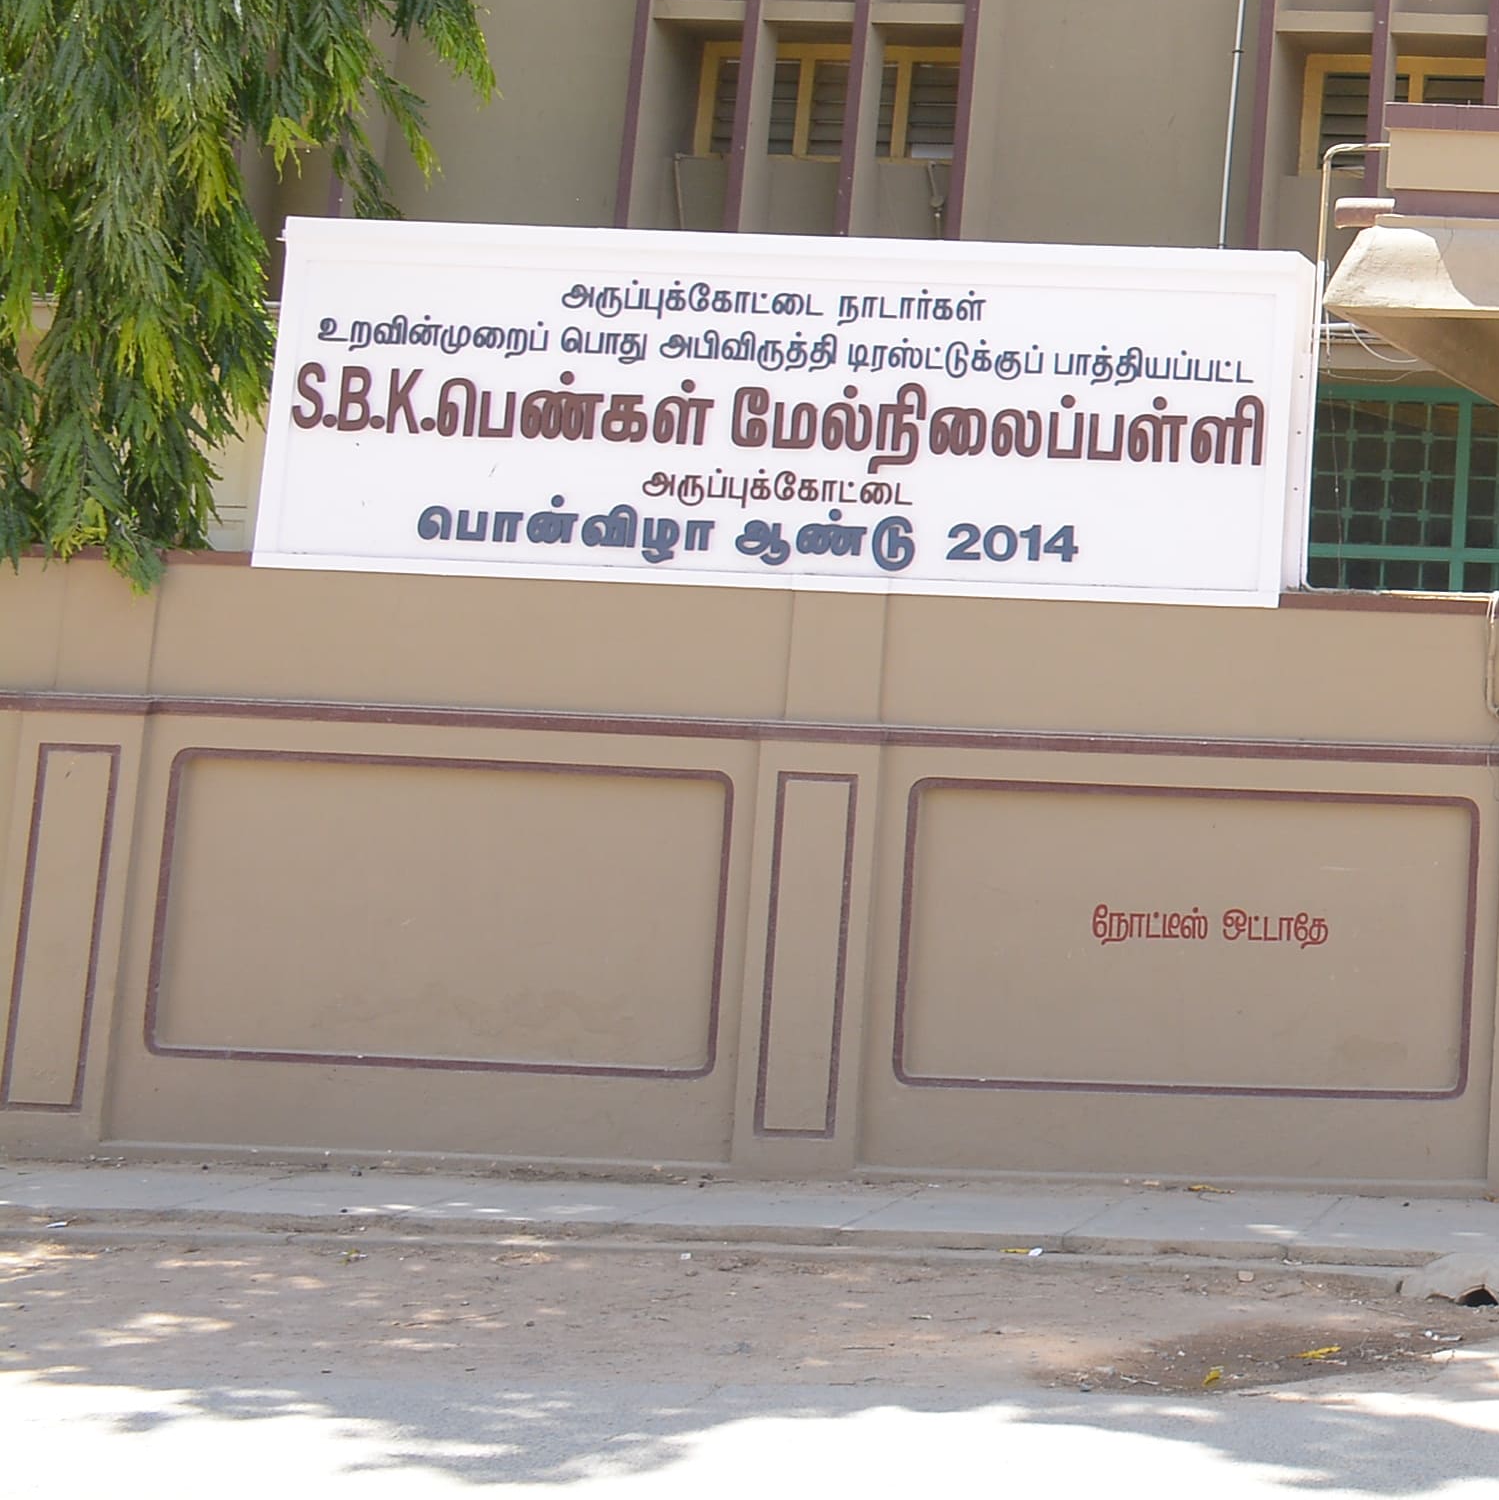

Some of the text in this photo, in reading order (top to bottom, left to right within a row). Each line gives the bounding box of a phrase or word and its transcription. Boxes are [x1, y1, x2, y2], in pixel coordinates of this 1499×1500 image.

[562, 279, 986, 325] அருப்புக்கோட்டை நாடார்கள்
[318, 315, 549, 358] உறவின்முறைப்
[561, 326, 647, 364] பொது
[660, 331, 837, 372] அபிவிருத்தி
[1054, 345, 1254, 386] பாத்தியப்பட்ட
[731, 383, 1265, 474] மேல்நிலைப்பள்ளி
[642, 468, 913, 508] அருப்புக்கோட்டை
[417, 495, 1079, 572] பொன்விழா ஆண்டு 2014
[1092, 904, 1329, 949] நோட்டீஸ் ஒட்டாதே
